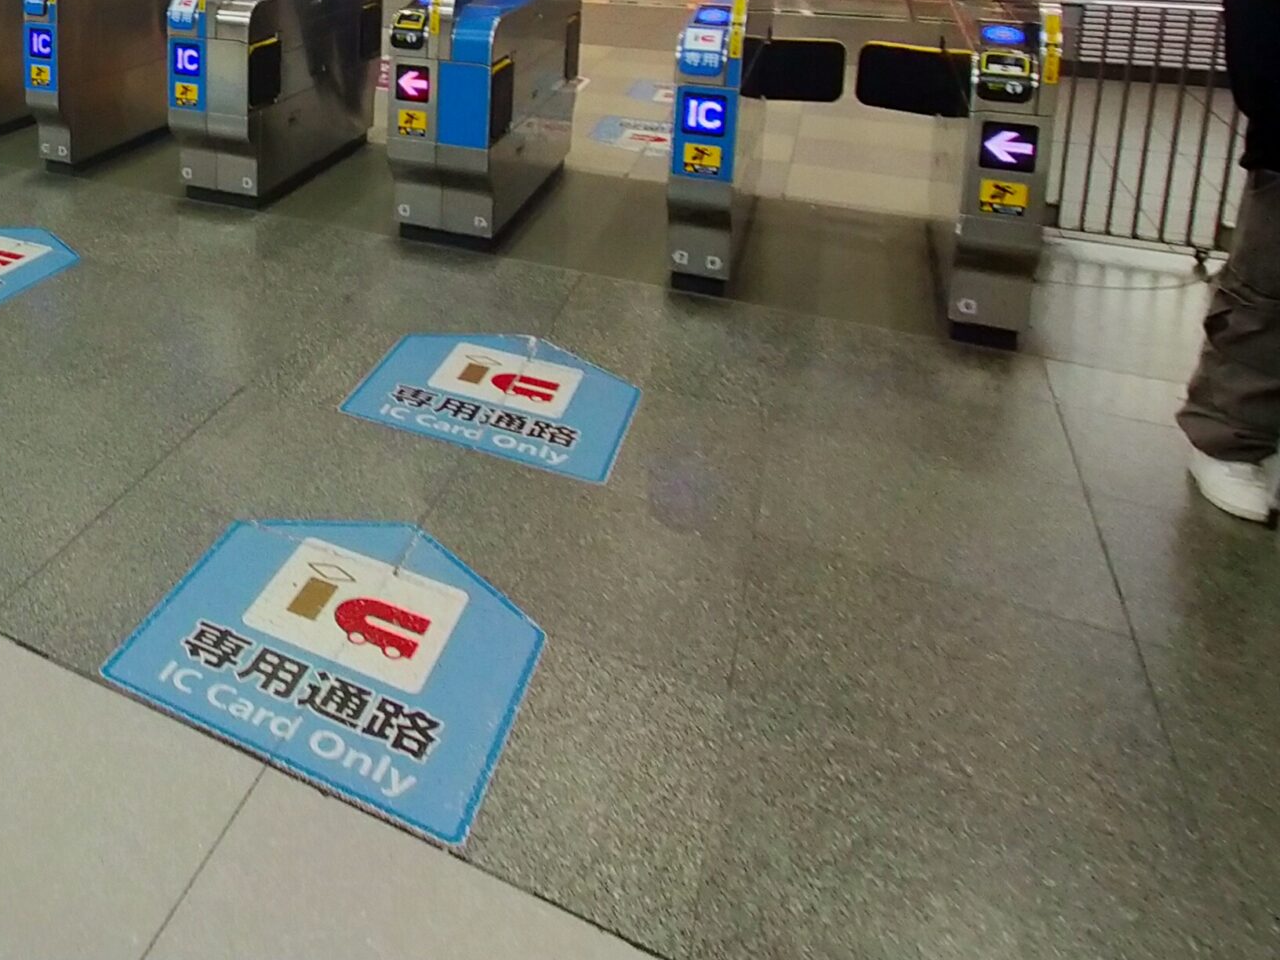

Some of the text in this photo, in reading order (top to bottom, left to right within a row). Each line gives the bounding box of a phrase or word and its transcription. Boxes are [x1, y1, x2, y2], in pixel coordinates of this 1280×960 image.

[32, 32, 52, 54] IC
[176, 47, 199, 71] IC
[683, 51, 720, 70] 専用
[687, 97, 724, 130] IC
[379, 402, 569, 466] IC Card Only
[389, 383, 583, 449] 専用通路
[179, 617, 444, 763] 専用通路
[157, 660, 418, 799] IC Card Only
